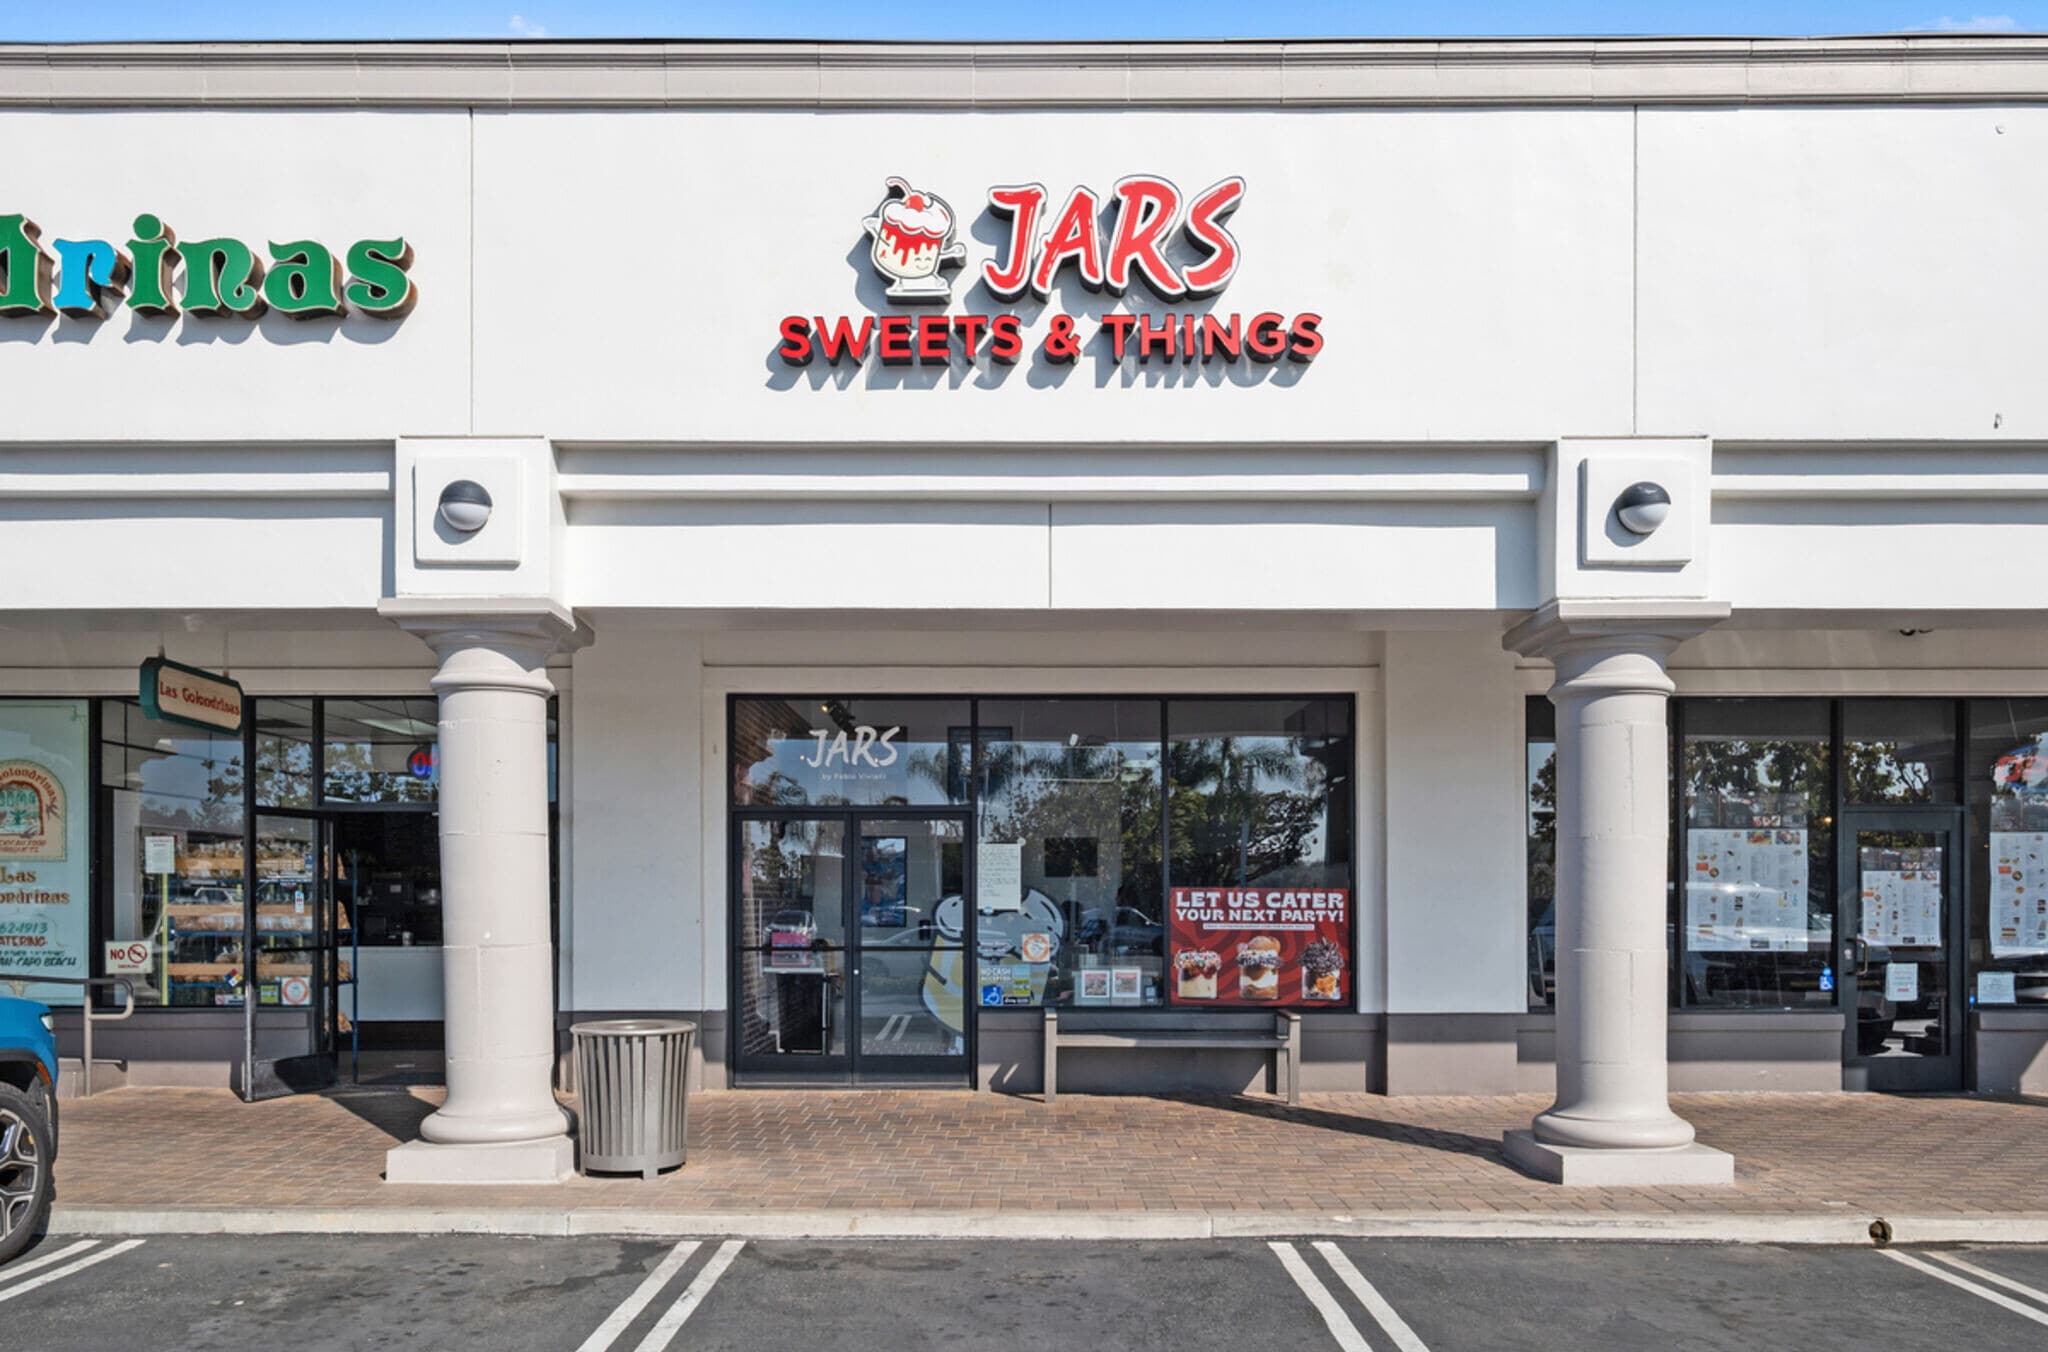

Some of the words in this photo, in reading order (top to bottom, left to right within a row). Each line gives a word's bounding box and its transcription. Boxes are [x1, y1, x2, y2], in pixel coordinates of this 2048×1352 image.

[981, 174, 1247, 302] JARS
[778, 314, 1023, 364] SWEETS
[1044, 313, 1083, 361] &
[1103, 312, 1325, 361] THINGS
[160, 681, 178, 698] Las
[807, 725, 900, 768] JARS
[1175, 891, 1221, 908] LET
[1227, 892, 1261, 908] US
[1266, 892, 1344, 909] CATER
[1175, 908, 1225, 921] YOUR
[1228, 909, 1277, 922] NEXT
[1281, 910, 1344, 923] PARTY!
[110, 949, 125, 961] NO
